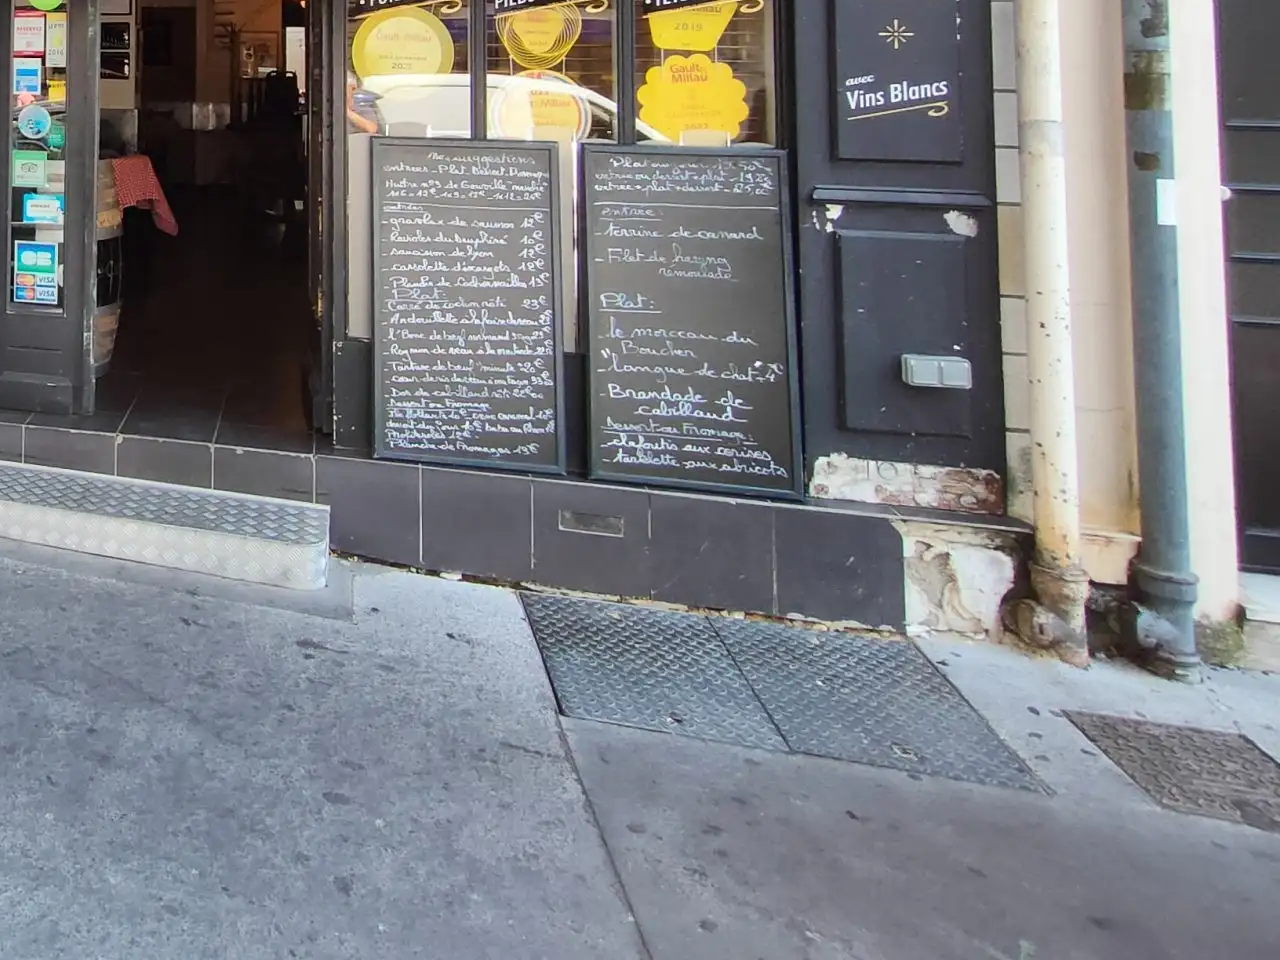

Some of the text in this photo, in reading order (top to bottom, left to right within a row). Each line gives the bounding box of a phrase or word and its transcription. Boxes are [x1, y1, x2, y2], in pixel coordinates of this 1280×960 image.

[845, 75, 875, 86] avec
[846, 80, 948, 111] Vins Blancs
